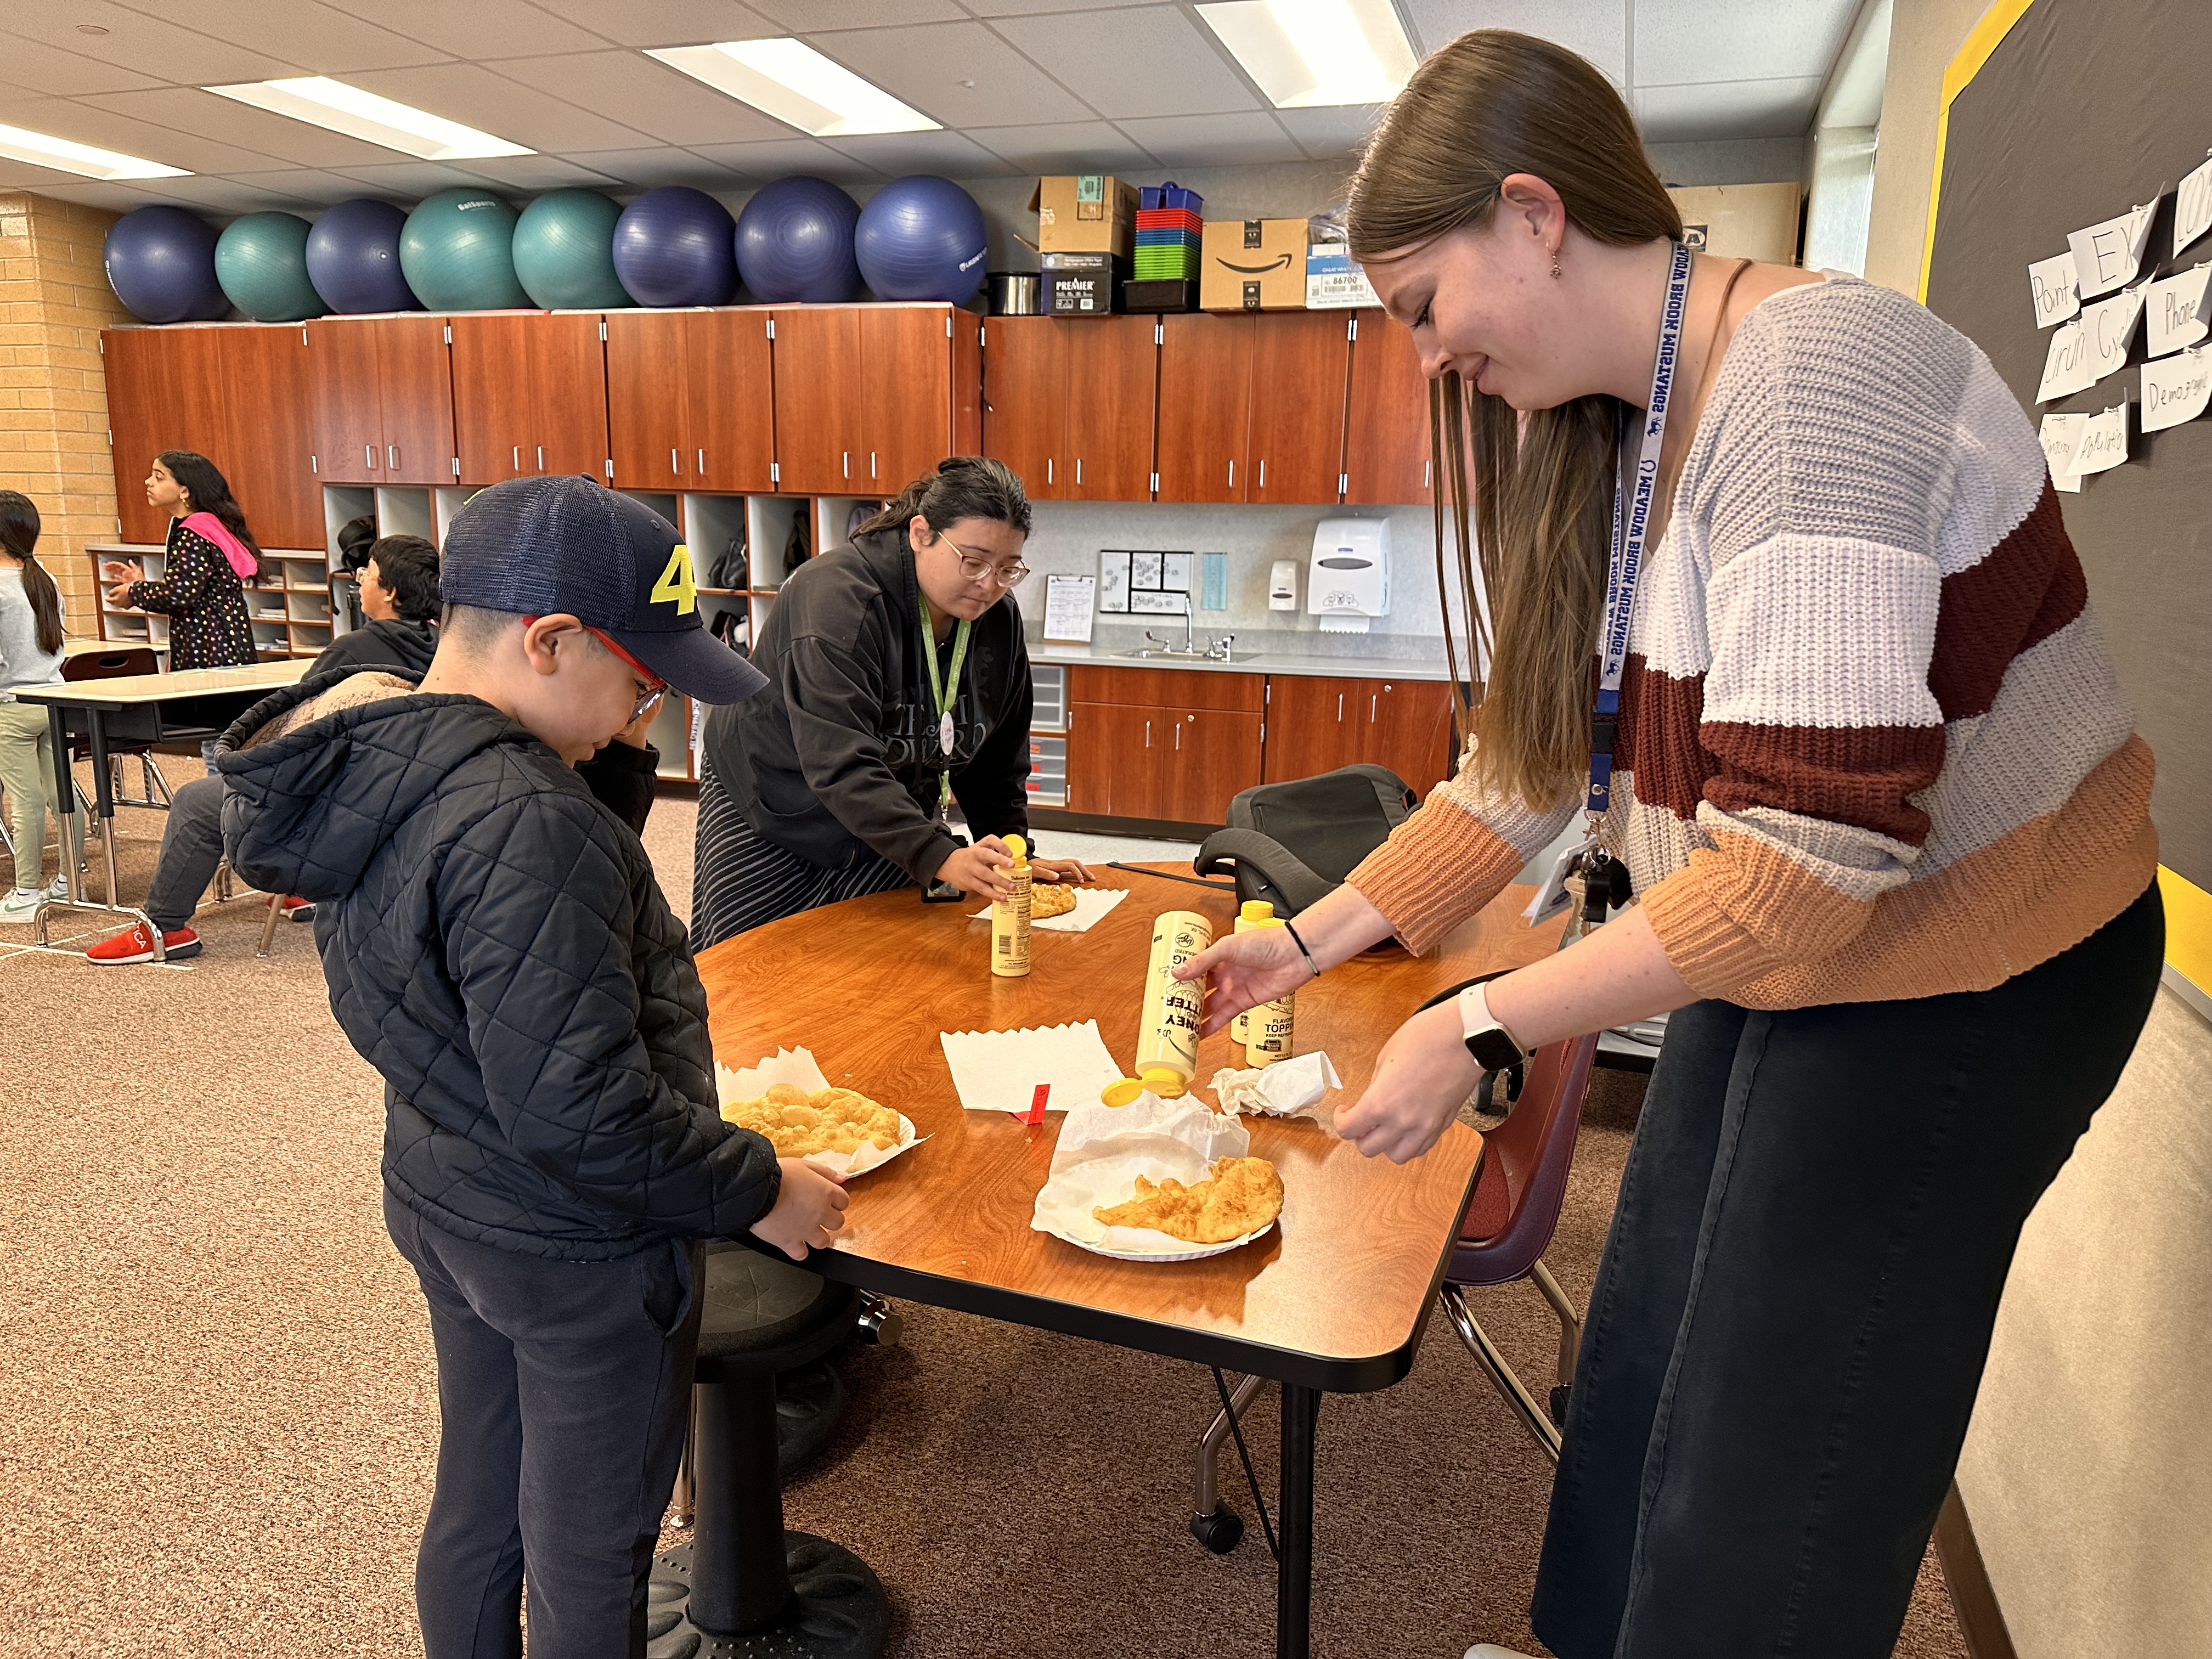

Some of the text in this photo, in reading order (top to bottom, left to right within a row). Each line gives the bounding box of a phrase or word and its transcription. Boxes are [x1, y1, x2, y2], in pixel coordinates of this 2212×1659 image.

[1056, 279, 1092, 291] PREMIER
[1333, 276, 1357, 285] 86700
[2032, 270, 2069, 321] Point
[2165, 292, 2196, 335] Phone
[650, 545, 697, 616] 4
[1165, 1014, 1200, 1035] ONEY
